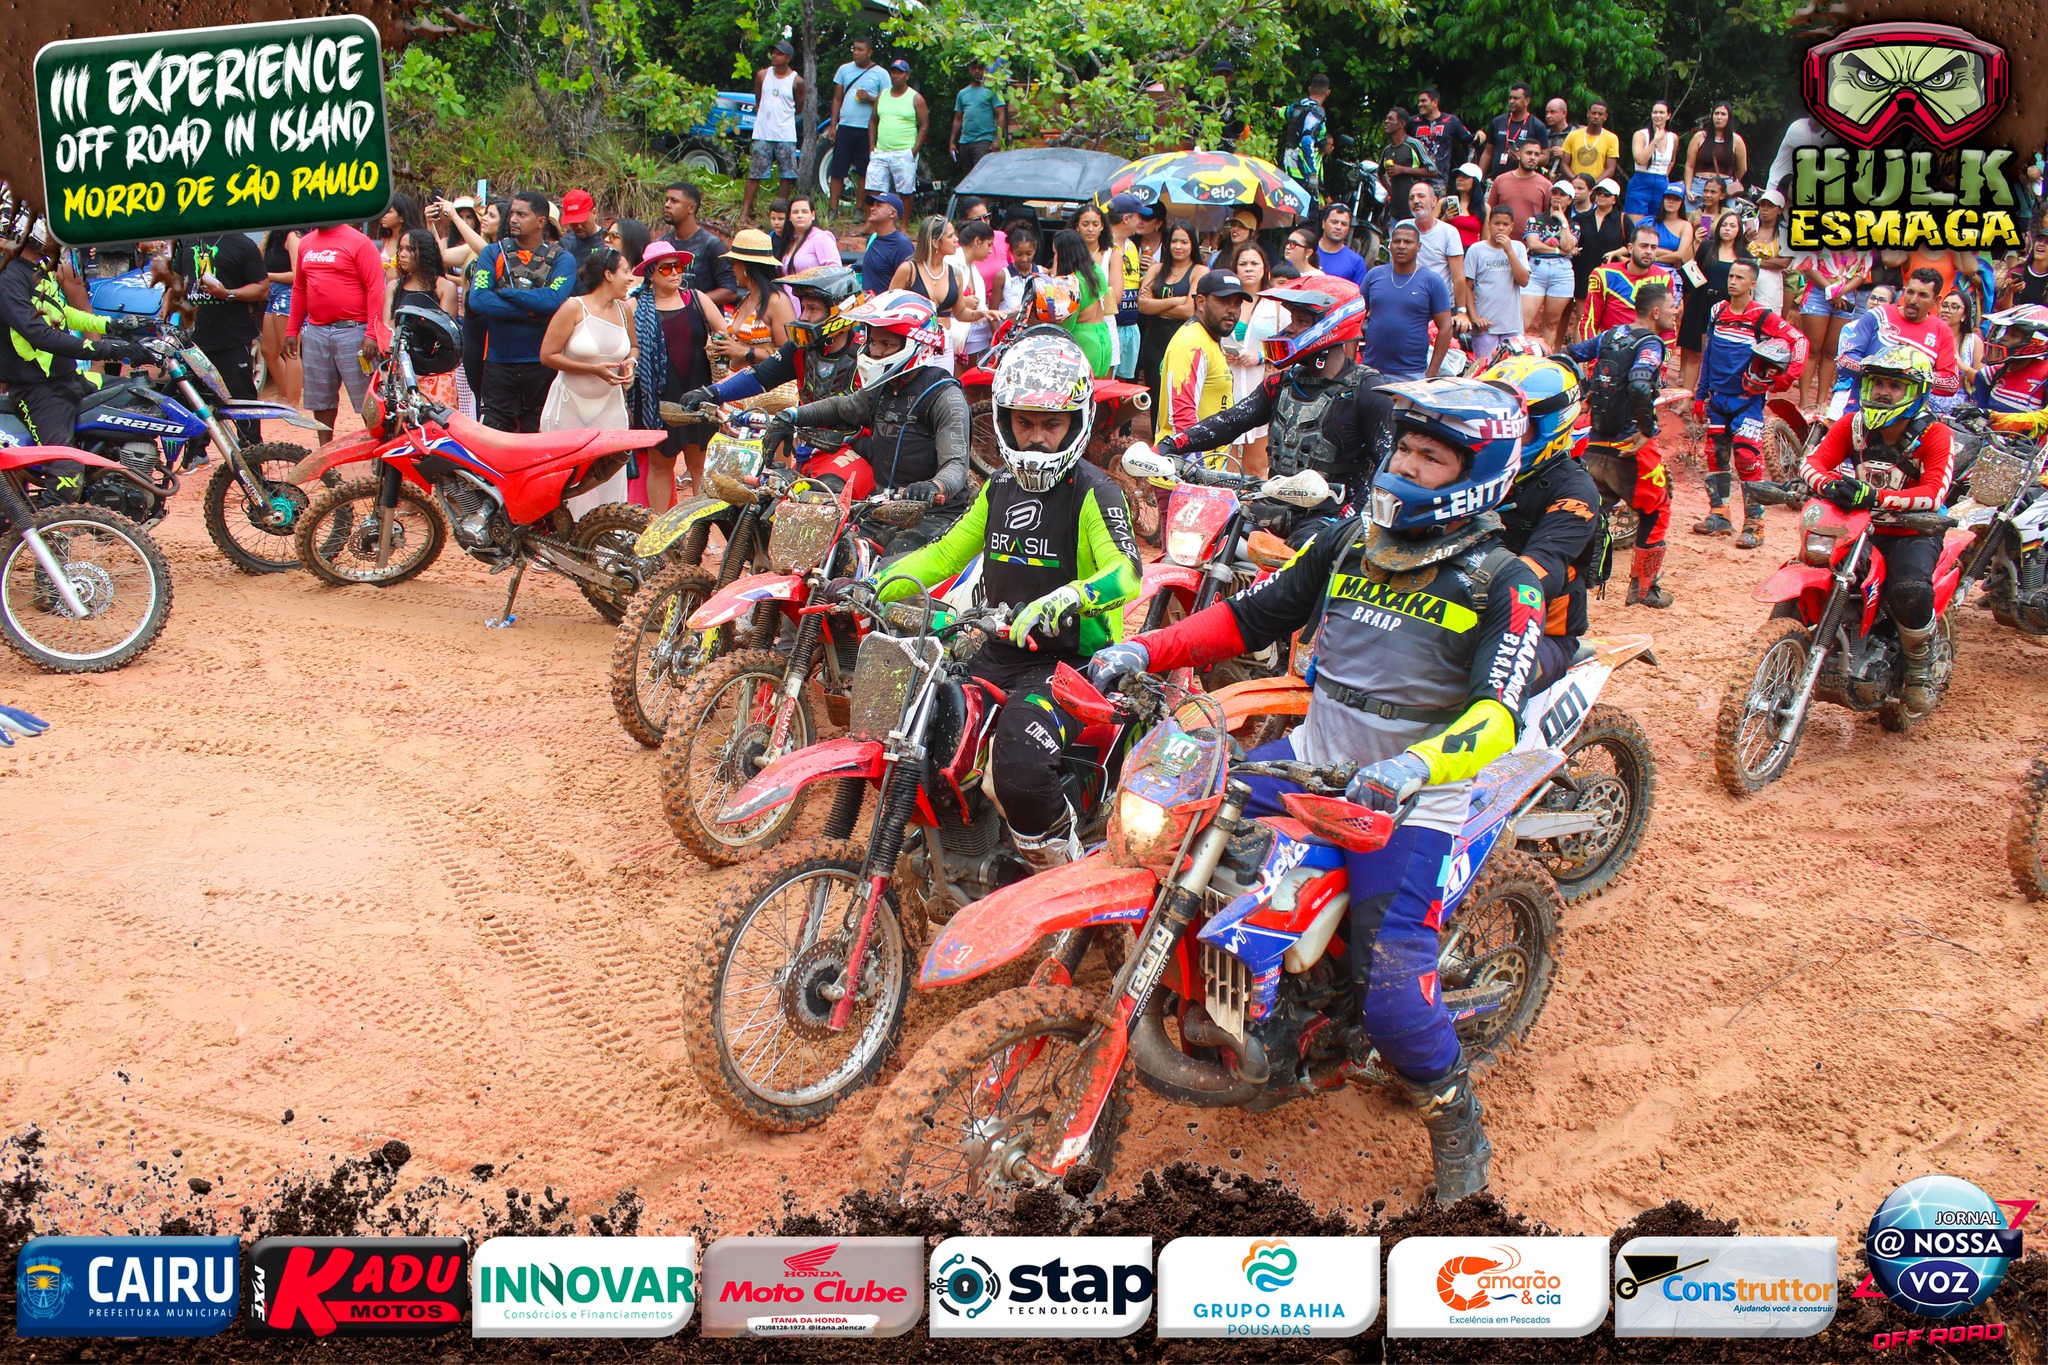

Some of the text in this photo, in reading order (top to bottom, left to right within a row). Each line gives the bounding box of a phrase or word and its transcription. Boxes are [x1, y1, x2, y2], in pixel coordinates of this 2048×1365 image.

[907, 326, 942, 347] 100%
[96, 413, 186, 435] KR250
[1128, 459, 1160, 473] ACERBIS
[1277, 489, 1309, 498] ACERBIS
[991, 532, 1058, 558] BRASIL
[1106, 505, 1141, 561] BRASIL
[1337, 576, 1448, 625] MAXAKA
[1351, 606, 1402, 632] BRAAP
[777, 699, 796, 746] SANTOS
[1539, 681, 1589, 748] 001
[1103, 908, 1141, 920] racing
[1135, 953, 1171, 1018] MOTOR SPORTS
